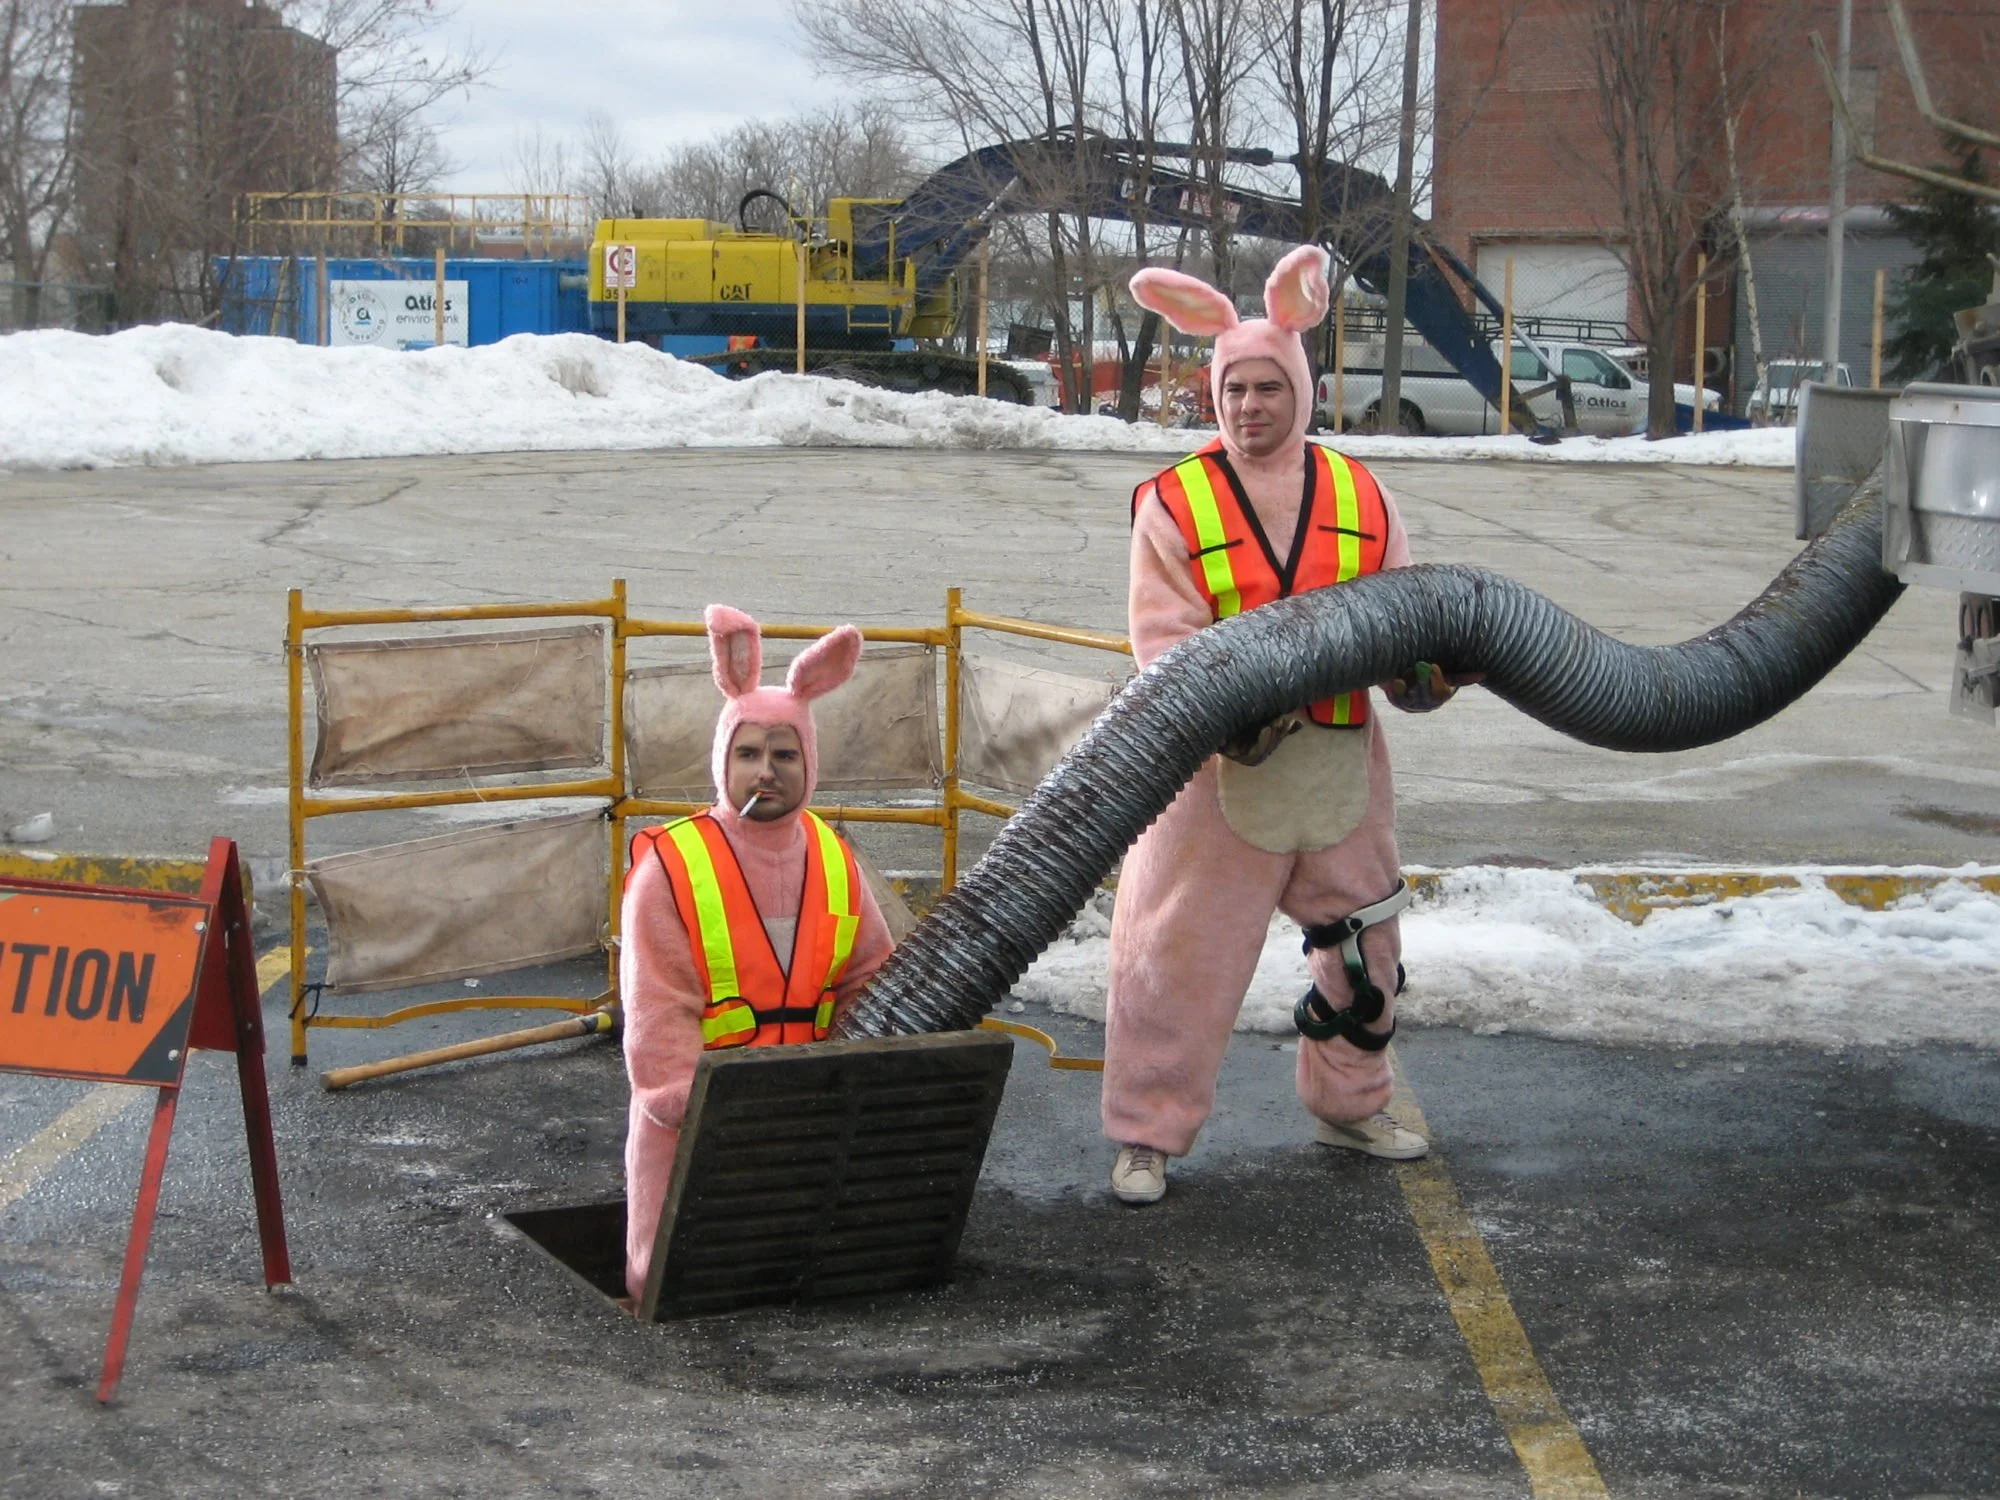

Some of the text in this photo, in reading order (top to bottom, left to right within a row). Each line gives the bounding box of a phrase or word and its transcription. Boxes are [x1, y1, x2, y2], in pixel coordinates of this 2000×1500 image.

[1120, 179, 1156, 204] CT
[720, 282, 752, 301] CAT
[0, 941, 156, 1025] TION
